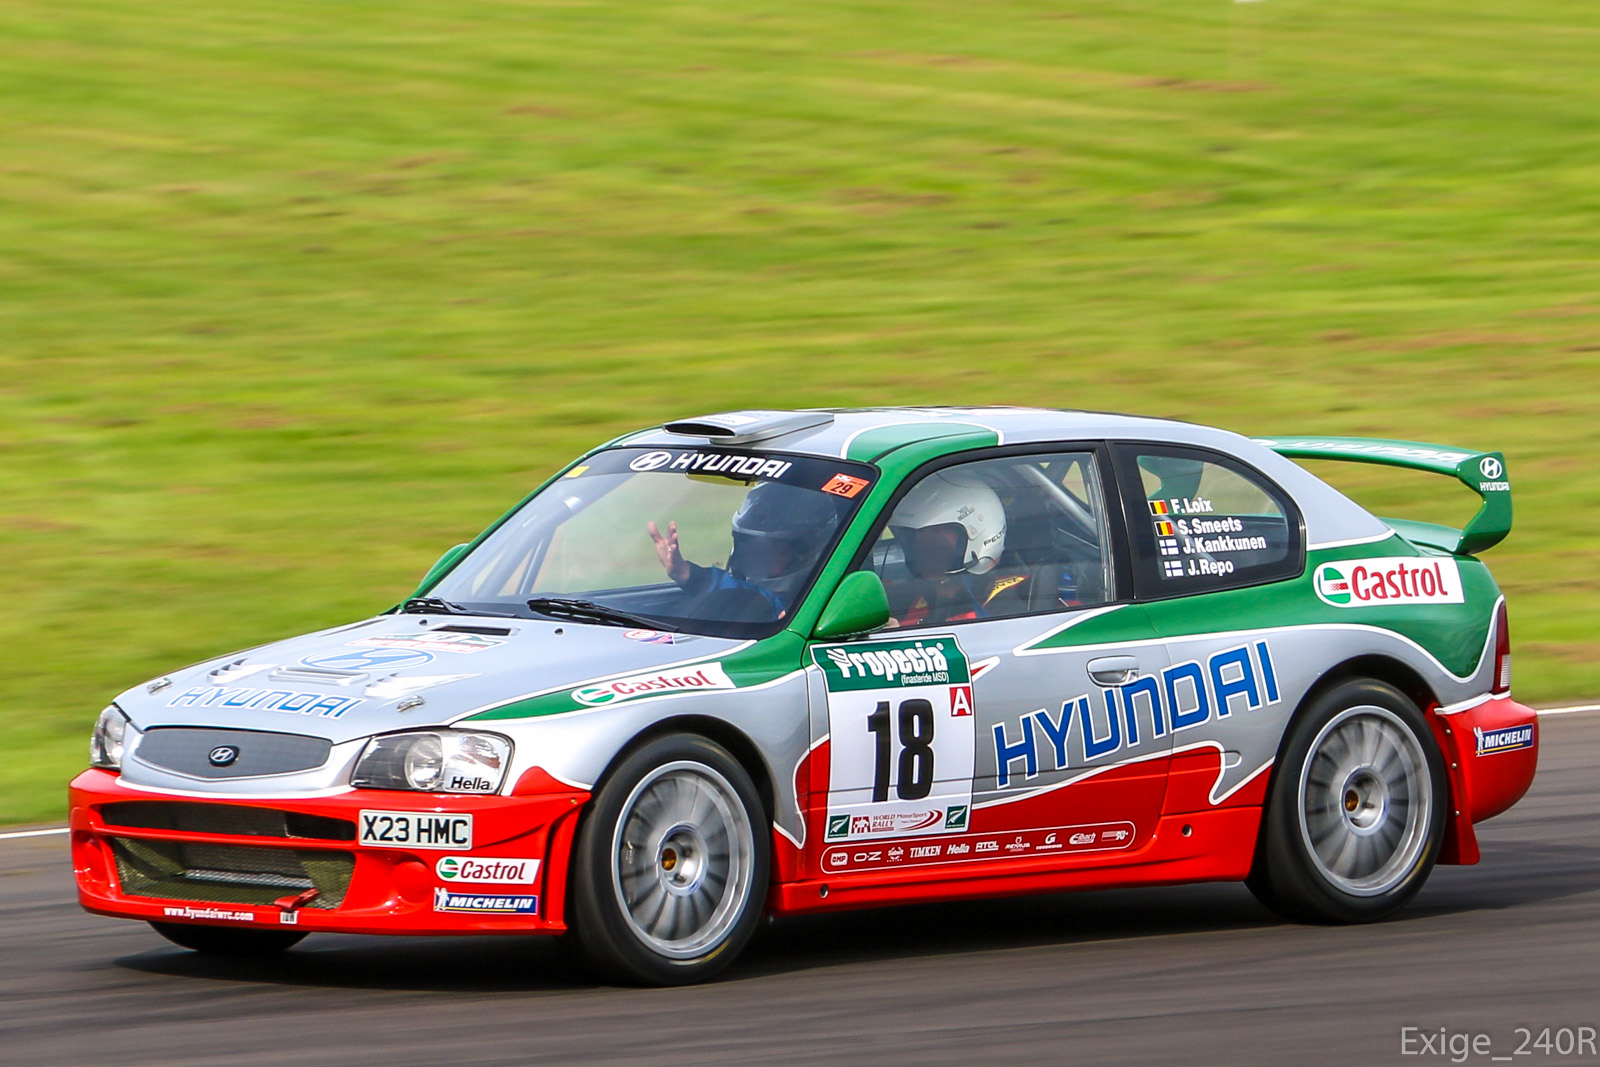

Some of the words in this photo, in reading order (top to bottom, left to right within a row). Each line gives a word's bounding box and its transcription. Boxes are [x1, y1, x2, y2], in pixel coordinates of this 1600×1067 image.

[670, 453, 792, 478] HYUNDAI
[830, 482, 853, 494] 29
[1479, 481, 1510, 491] HYUNDAI
[1170, 497, 1213, 514] F.Loix
[1177, 517, 1243, 535] S.Smeets
[1182, 535, 1267, 554] J.Kankkunen
[1187, 559, 1234, 576] J.Repo
[1352, 562, 1448, 601] Castrol
[611, 670, 717, 695] Castrol
[166, 686, 367, 720] HYUNDAI
[952, 688, 971, 715] A
[990, 640, 1281, 789] HYUNDAI
[1484, 728, 1532, 749] MICHELIN
[867, 698, 935, 803] 18
[450, 776, 490, 791] Hella
[363, 815, 410, 842] X23
[416, 817, 468, 844] HMC
[872, 820, 894, 828] RALLY
[910, 845, 942, 858] TIMKEN
[946, 843, 970, 854] Hella
[460, 860, 526, 880] Castrol
[448, 897, 533, 909] MICHELIN
[163, 906, 254, 921] www.hyundaiwrc.com
